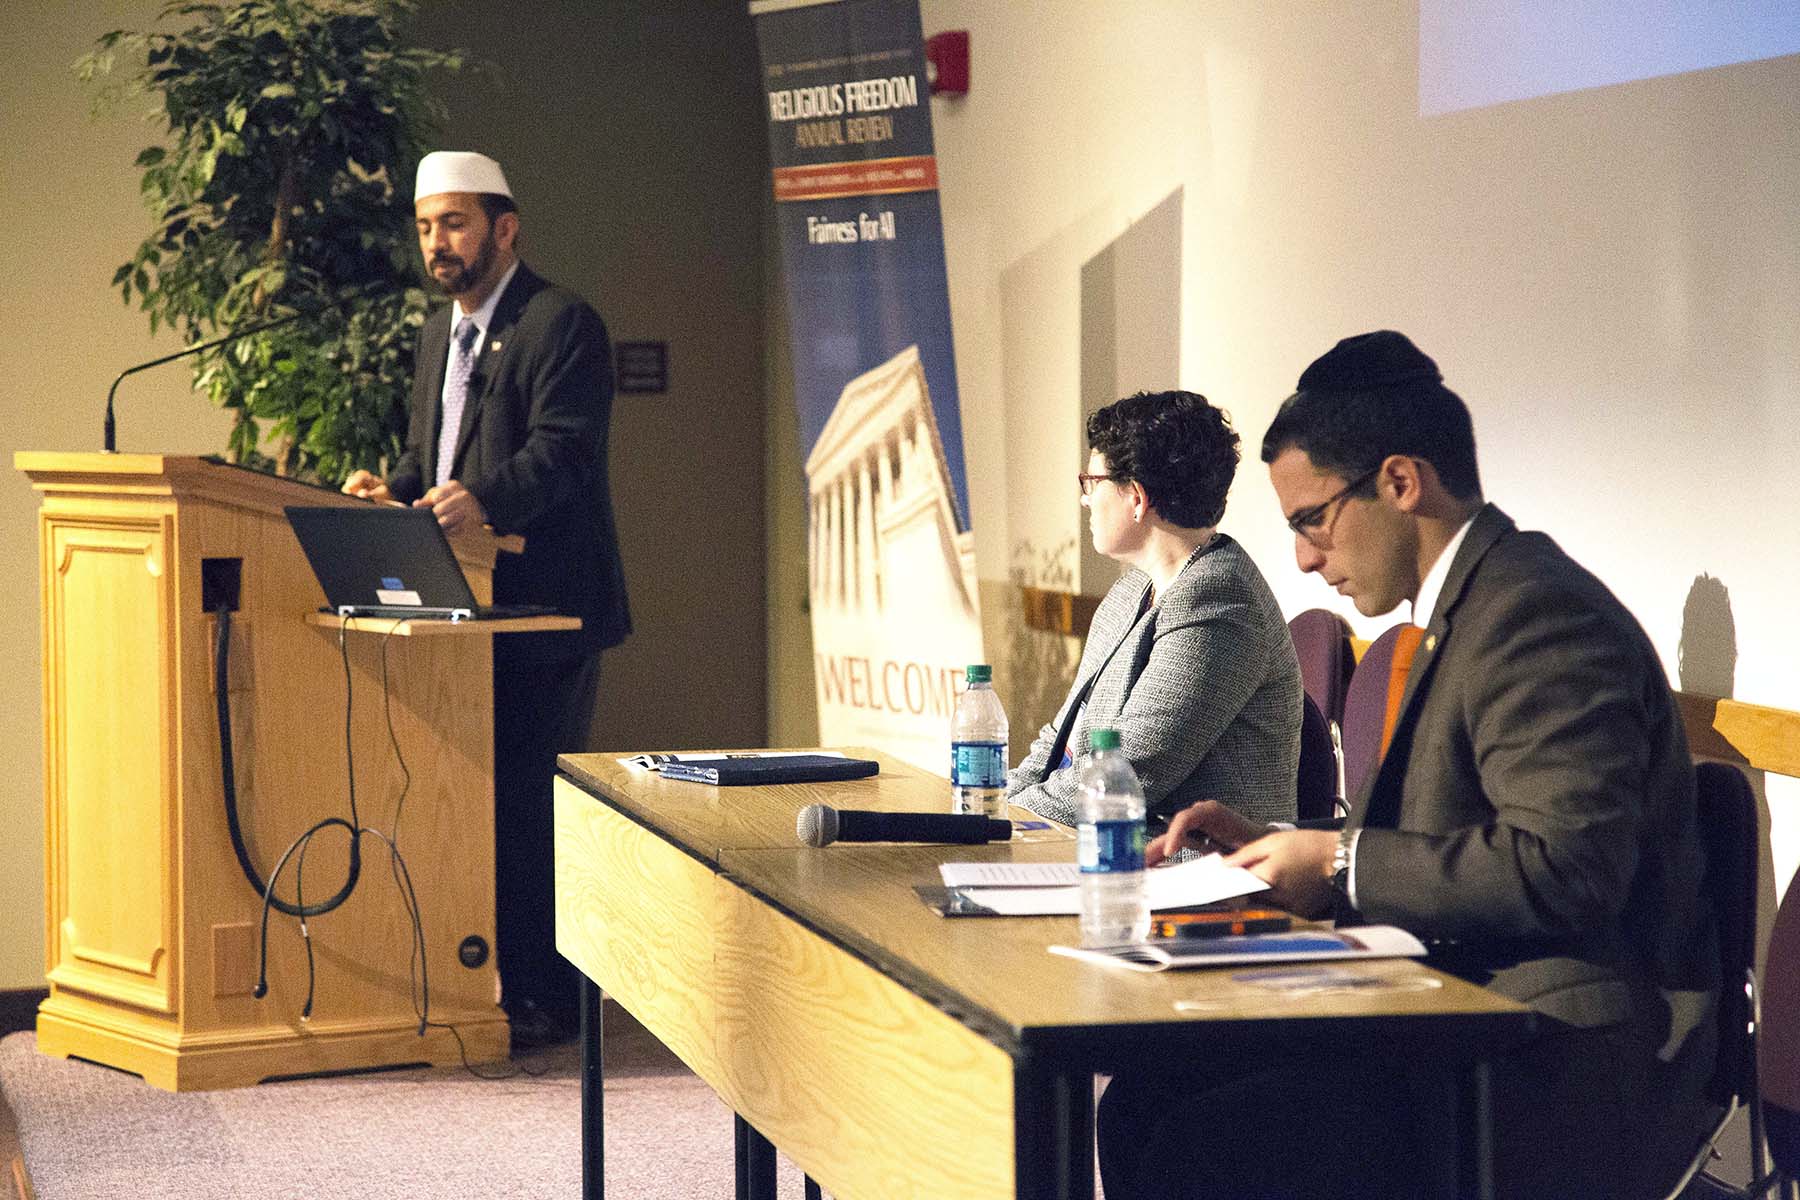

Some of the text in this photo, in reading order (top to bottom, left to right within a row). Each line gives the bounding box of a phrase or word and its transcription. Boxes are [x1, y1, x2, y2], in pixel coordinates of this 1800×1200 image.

[768, 75, 918, 121] RELIGIOUS FREEDOM
[807, 210, 897, 244] Fairness for All
